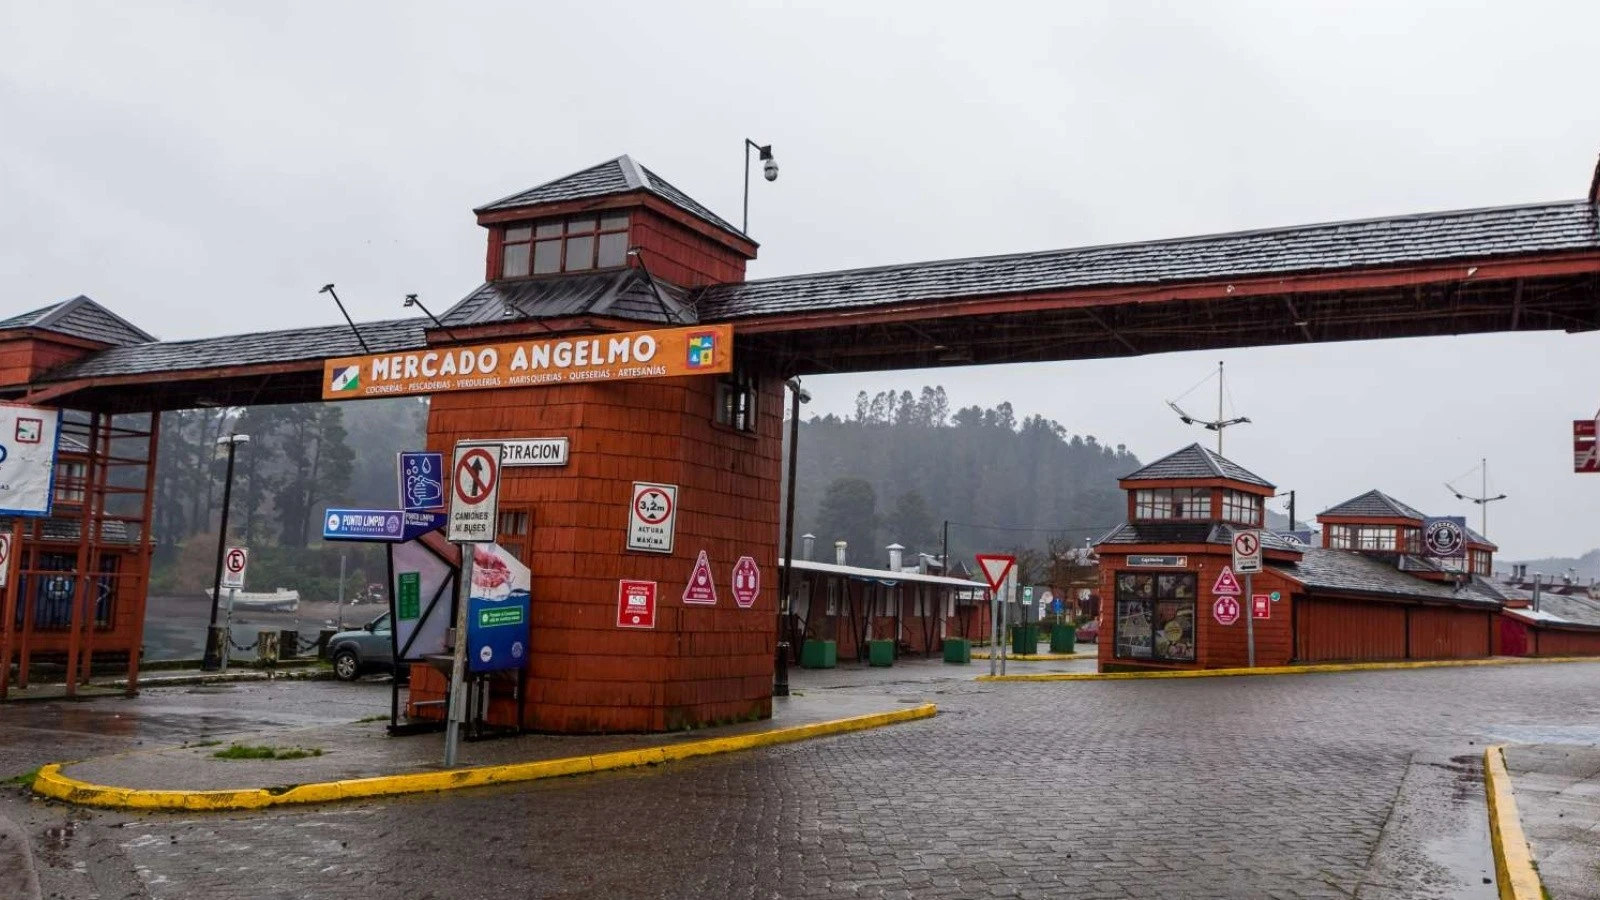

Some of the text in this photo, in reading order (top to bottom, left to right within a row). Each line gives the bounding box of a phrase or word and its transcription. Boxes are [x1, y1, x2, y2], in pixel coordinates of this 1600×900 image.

[371, 335, 656, 381] MERCADO ANGELMO
[640, 501, 665, 511] 3,2m
[343, 515, 385, 527] PUNTO LIMPIO
[455, 511, 489, 521] CAMIONES
[464, 523, 486, 532] BUSES
[638, 526, 664, 534] ALTURA
